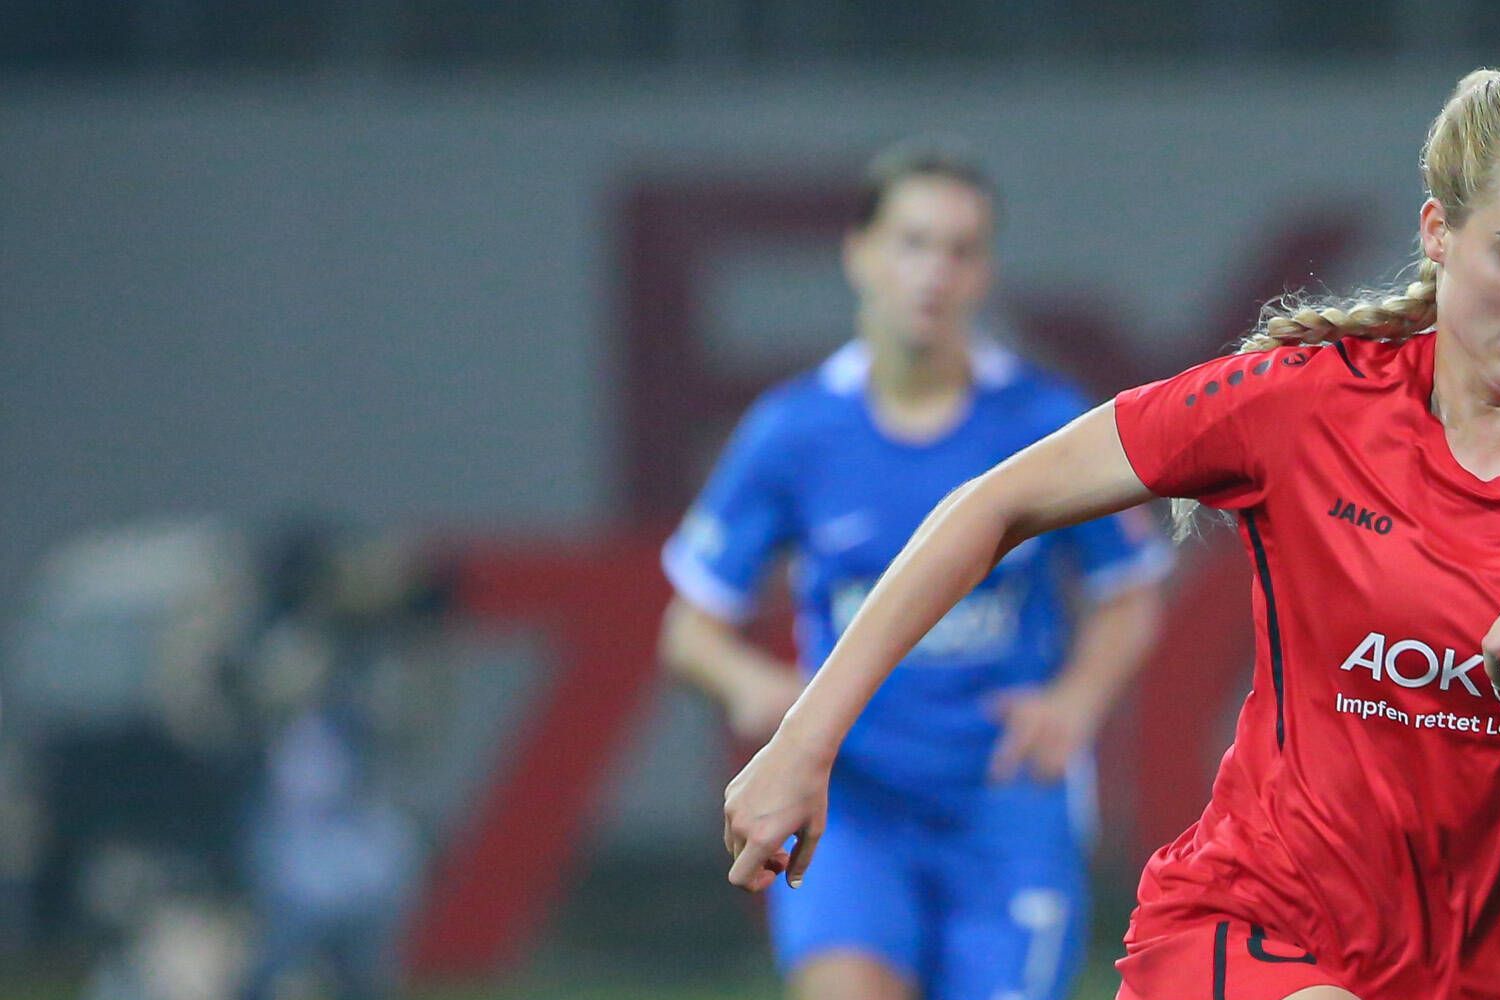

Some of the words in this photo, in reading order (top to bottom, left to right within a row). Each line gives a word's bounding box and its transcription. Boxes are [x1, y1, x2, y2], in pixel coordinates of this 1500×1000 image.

[1328, 498, 1393, 535] JAKO
[1340, 631, 1484, 697] AOK
[1336, 692, 1409, 726] Impfen
[1415, 711, 1481, 733] rettet
